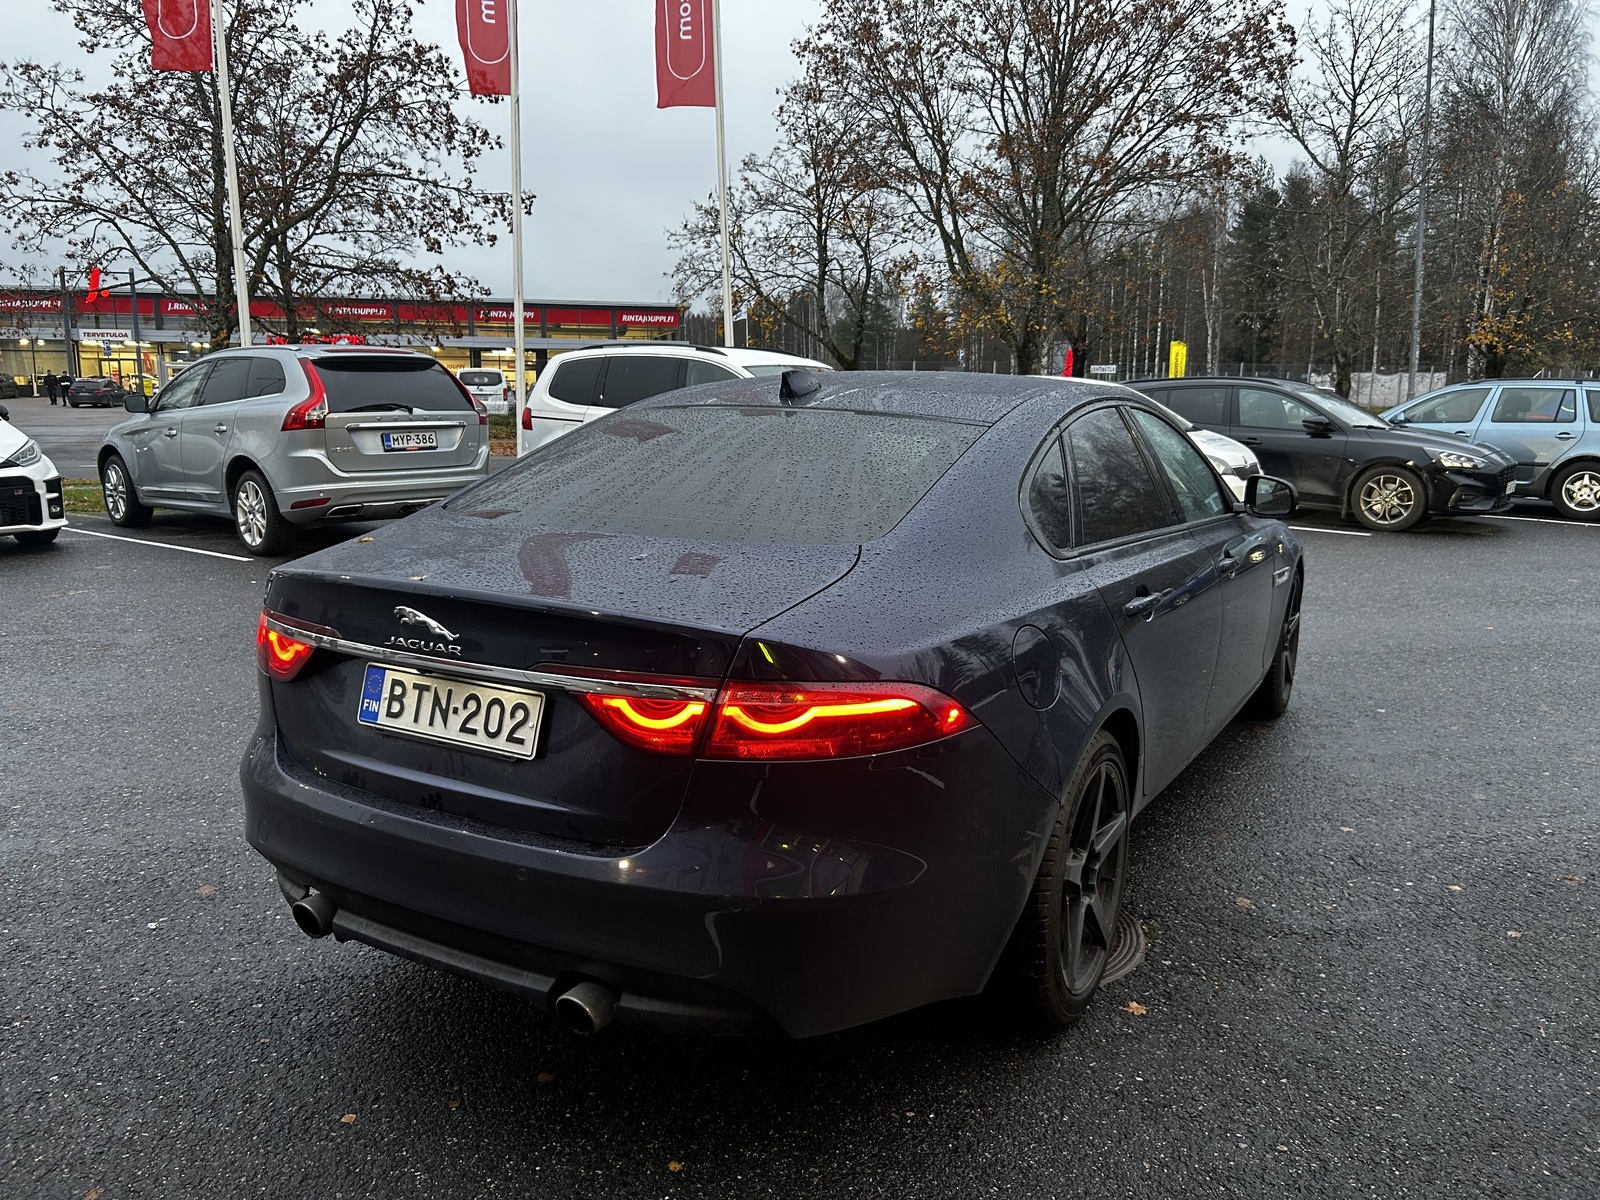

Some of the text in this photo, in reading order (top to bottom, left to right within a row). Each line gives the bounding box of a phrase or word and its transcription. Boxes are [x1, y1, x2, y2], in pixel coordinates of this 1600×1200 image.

[679, 0, 692, 40] mo
[622, 314, 674, 323] RINTAJOUPPI.FI
[391, 433, 435, 446] MYP-386
[383, 635, 463, 656] JAGUAR
[363, 677, 529, 746] FIN BTN-202
